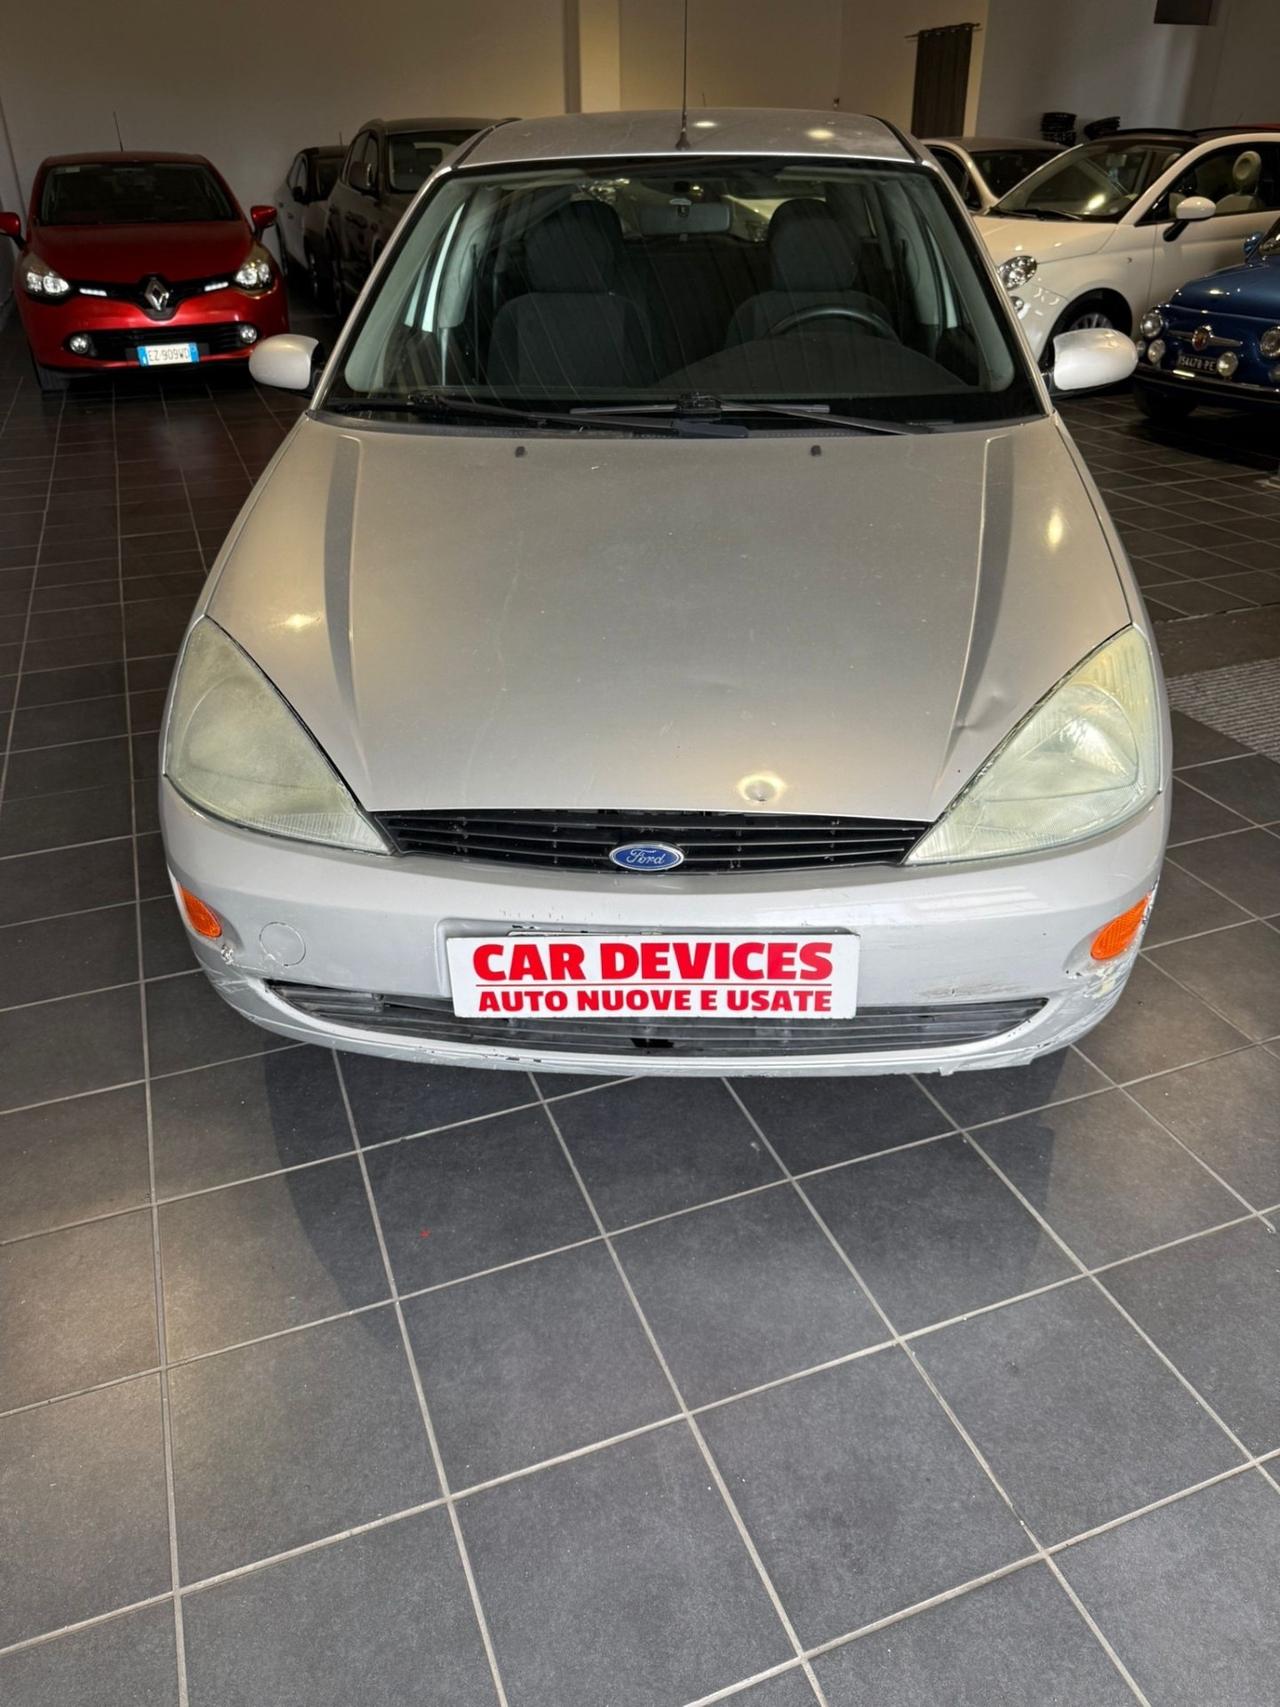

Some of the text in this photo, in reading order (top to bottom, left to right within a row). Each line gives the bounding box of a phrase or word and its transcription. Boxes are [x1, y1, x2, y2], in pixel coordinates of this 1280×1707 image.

[626, 848, 666, 864] Ford
[473, 942, 833, 981] CAR DEVICES
[478, 989, 832, 1012] AUTO NUOVE E USATE
